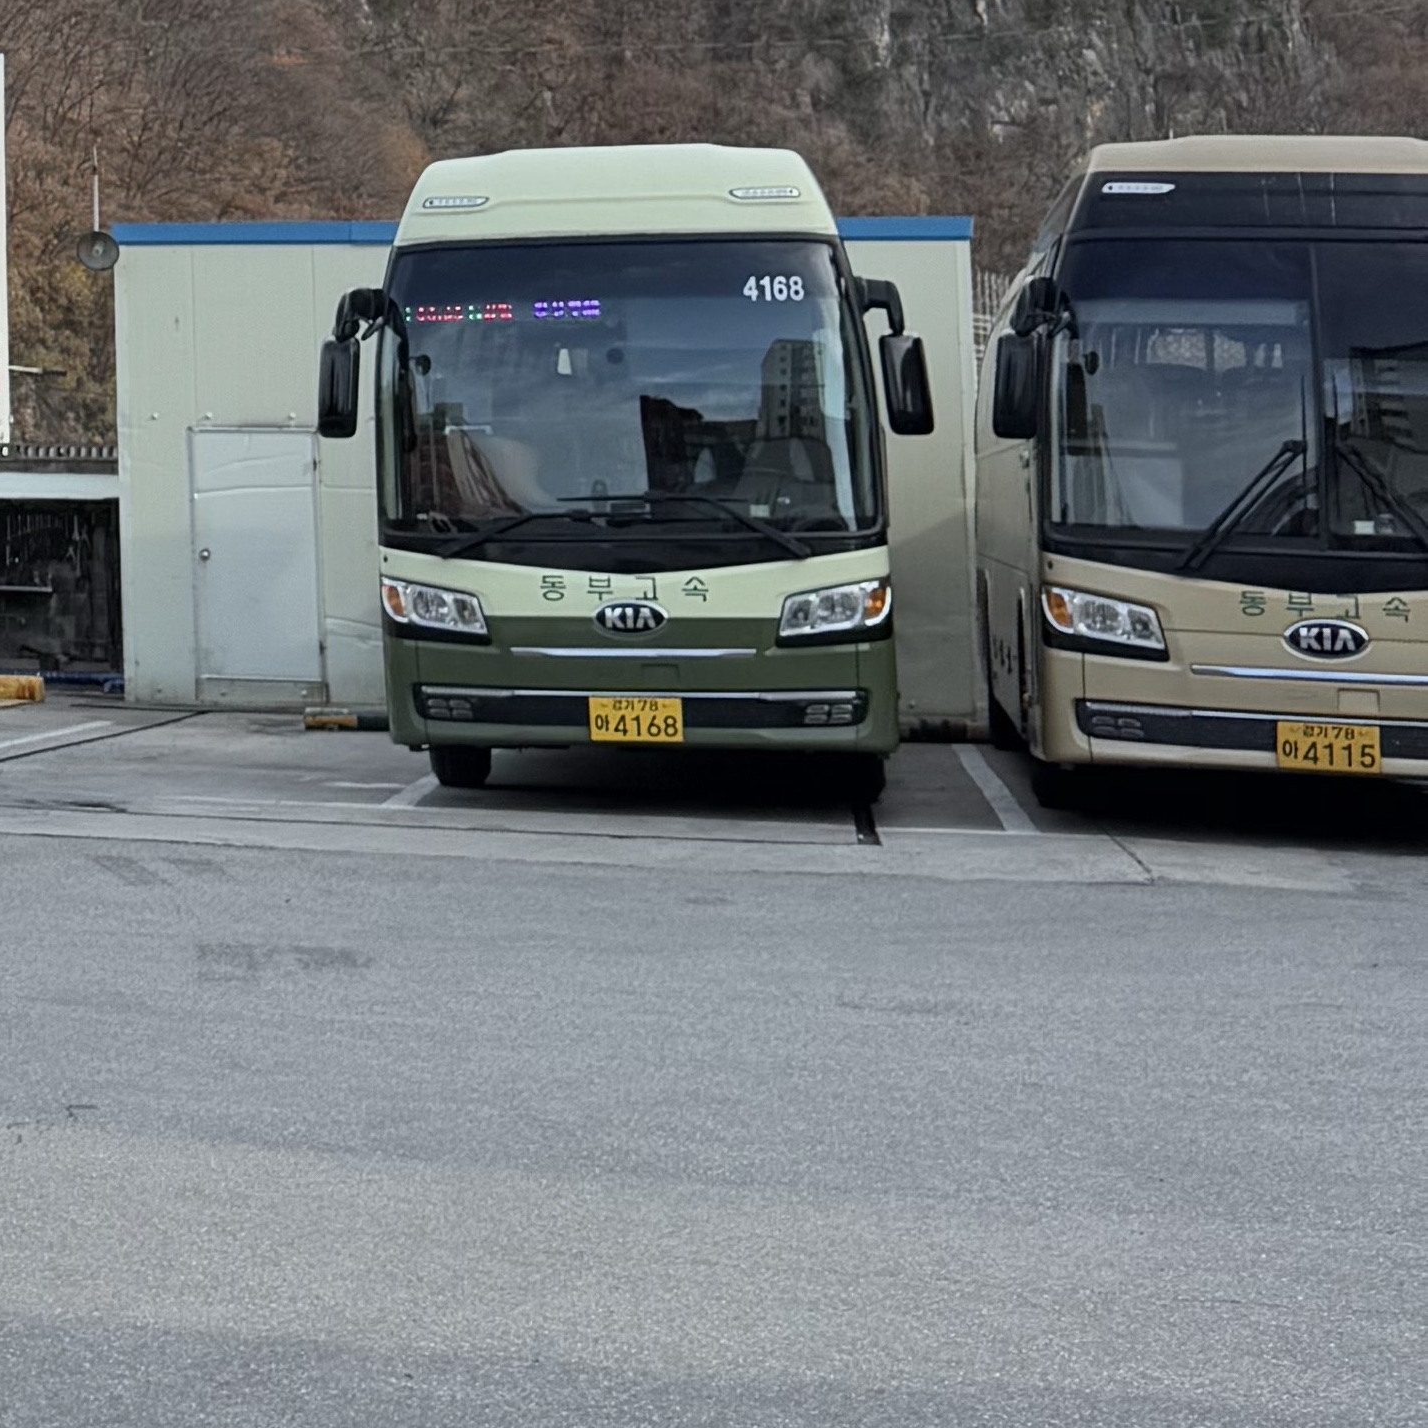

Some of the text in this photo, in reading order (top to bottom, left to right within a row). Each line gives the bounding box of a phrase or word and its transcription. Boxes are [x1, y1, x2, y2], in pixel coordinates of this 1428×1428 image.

[742, 274, 805, 302] 4168
[603, 606, 657, 630] KIA
[1298, 626, 1356, 652] KIA
